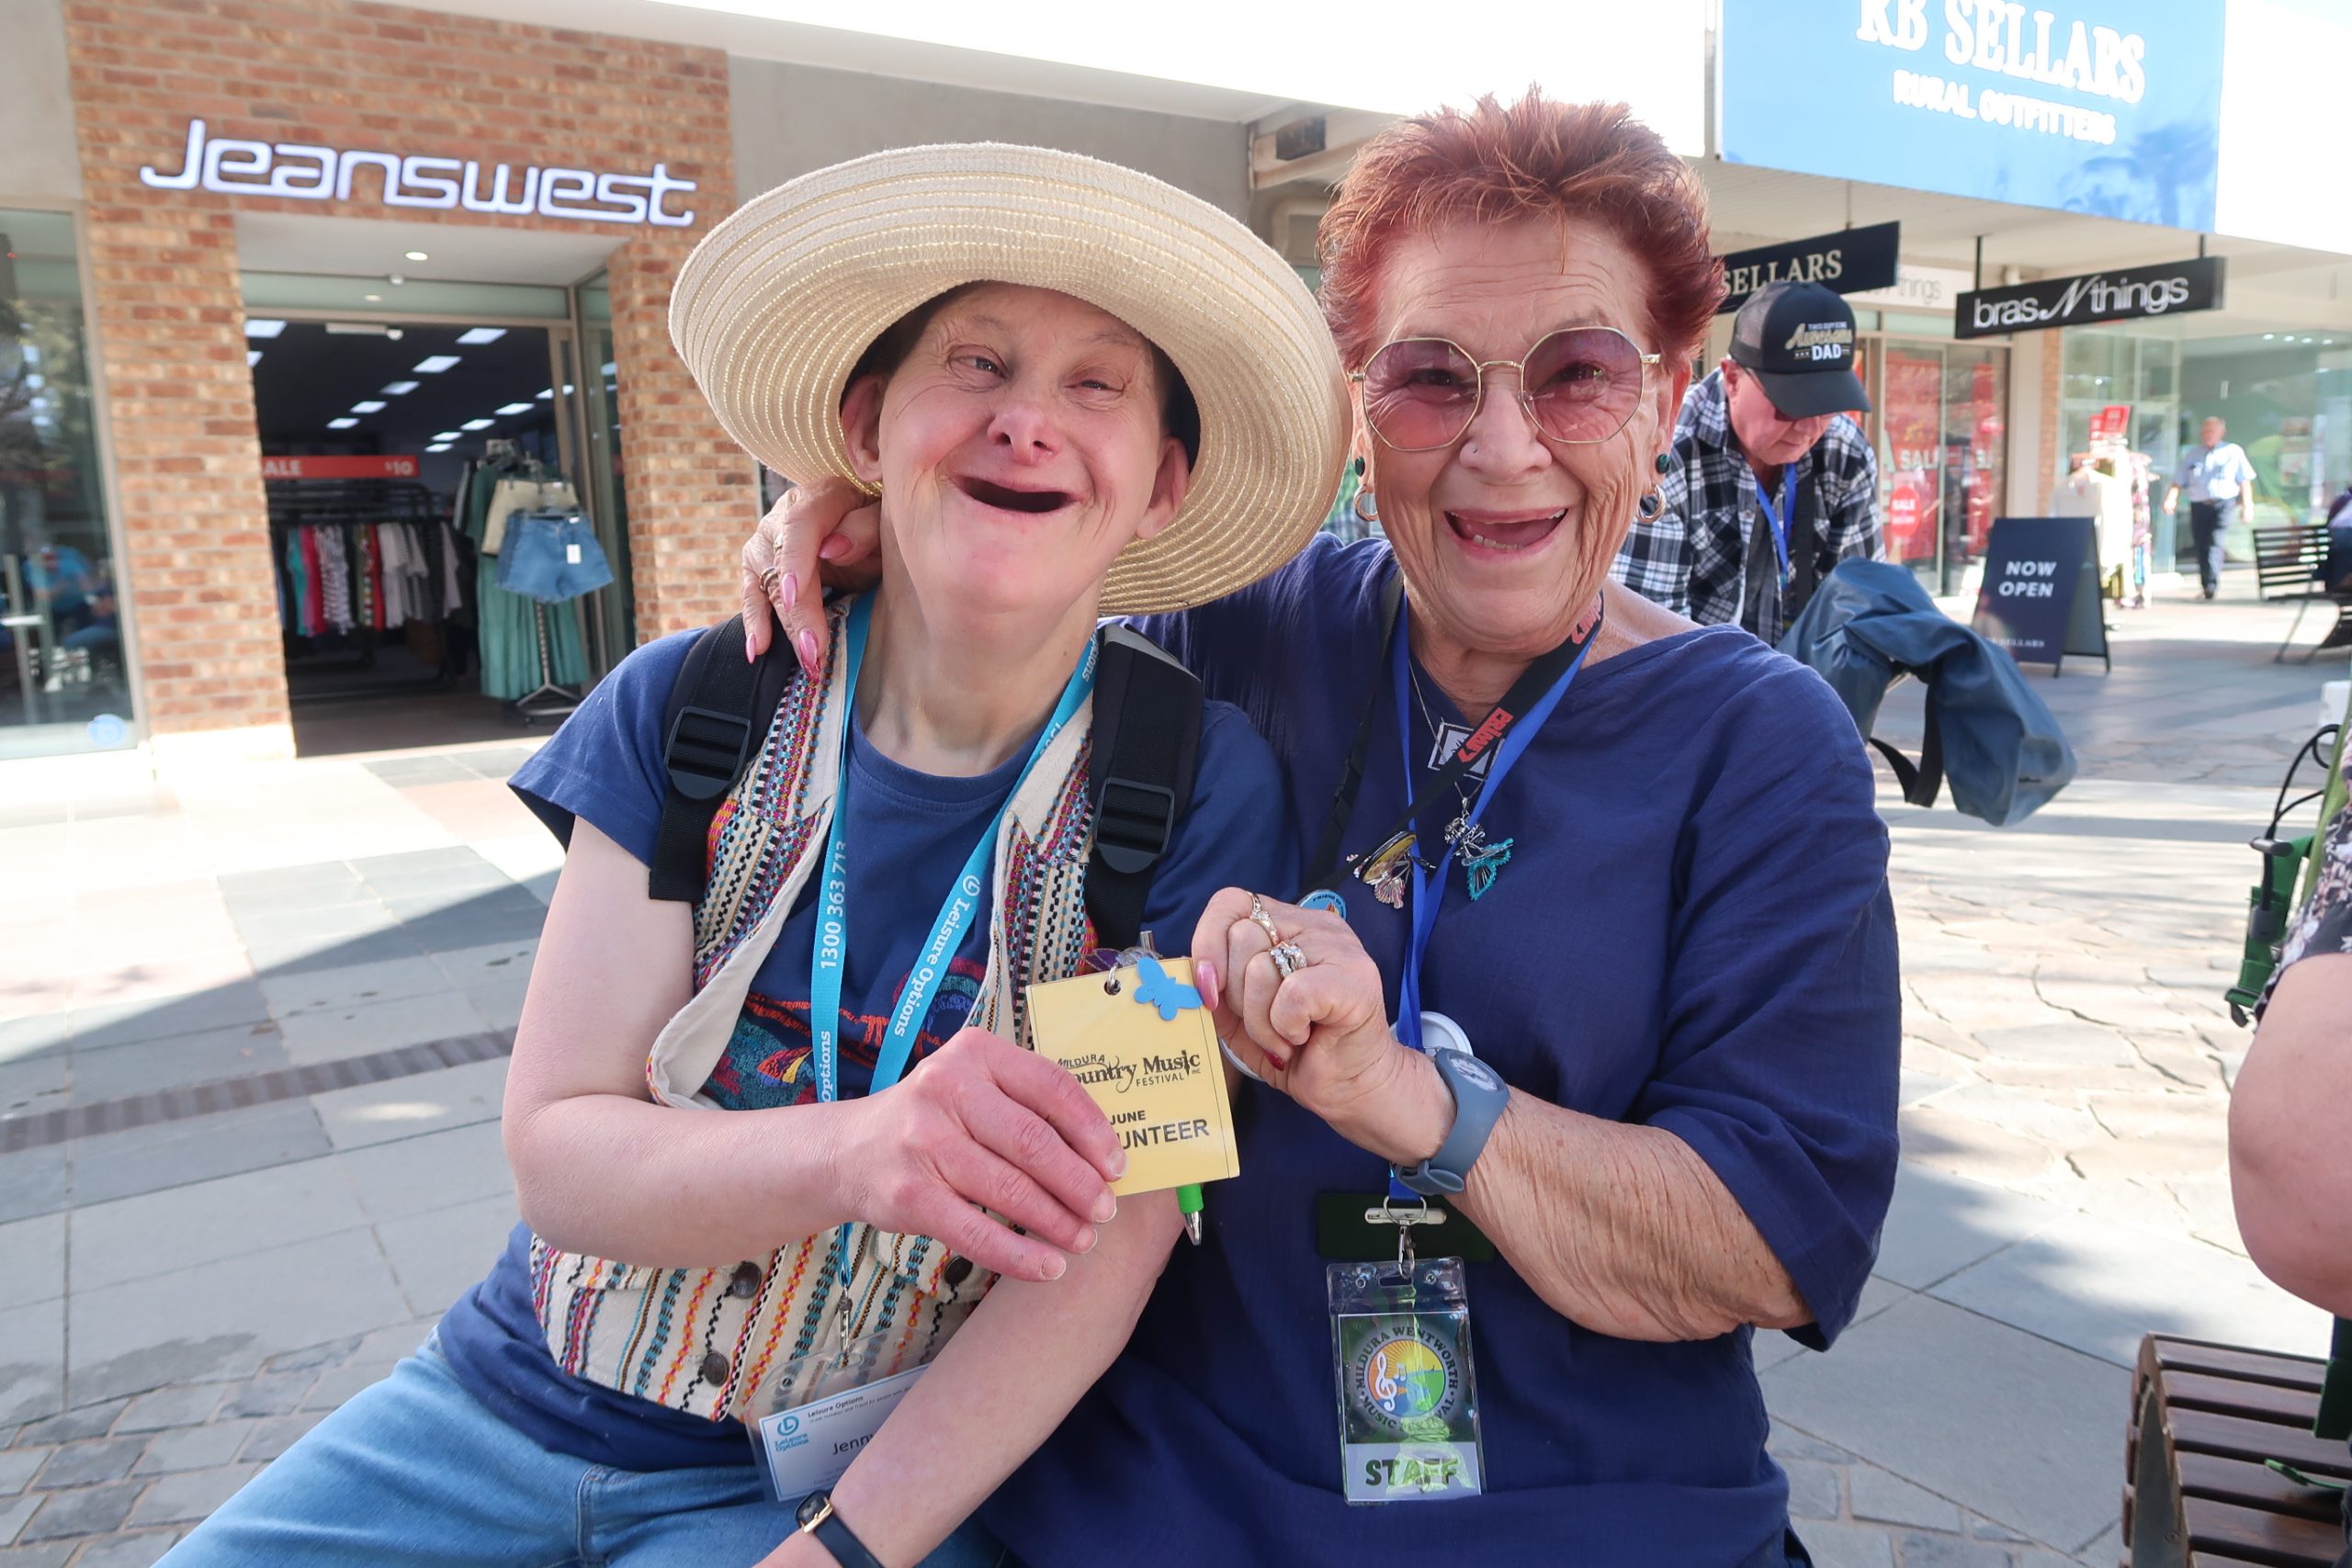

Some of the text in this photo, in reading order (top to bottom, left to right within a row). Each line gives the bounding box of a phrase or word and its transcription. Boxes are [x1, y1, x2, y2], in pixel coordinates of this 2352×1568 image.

[1944, 0, 2146, 104] SELLARS
[1894, 69, 2116, 145] RURAL OUTFITTERS
[140, 118, 696, 227] Jeanswest
[1973, 296, 2039, 328] bras
[2089, 276, 2188, 314] things
[1812, 344, 1841, 360] DAD
[263, 460, 301, 476] ALE
[2005, 561, 2057, 577] NOW
[1998, 581, 2054, 597] OPEN
[827, 878, 846, 919] 363
[820, 921, 842, 969] 1300
[894, 897, 970, 1037] Leisure Options
[1073, 1049, 1201, 1093] ountry Music
[1136, 1072, 1185, 1088] FESTIVAL
[1109, 1110, 1147, 1125] JUNE
[1117, 1118, 1211, 1150] UNTEER
[1356, 1325, 1459, 1391] MILDURA WENTWORTH
[808, 1394, 864, 1418] Leisure Options
[1362, 1395, 1397, 1429] MUSIC
